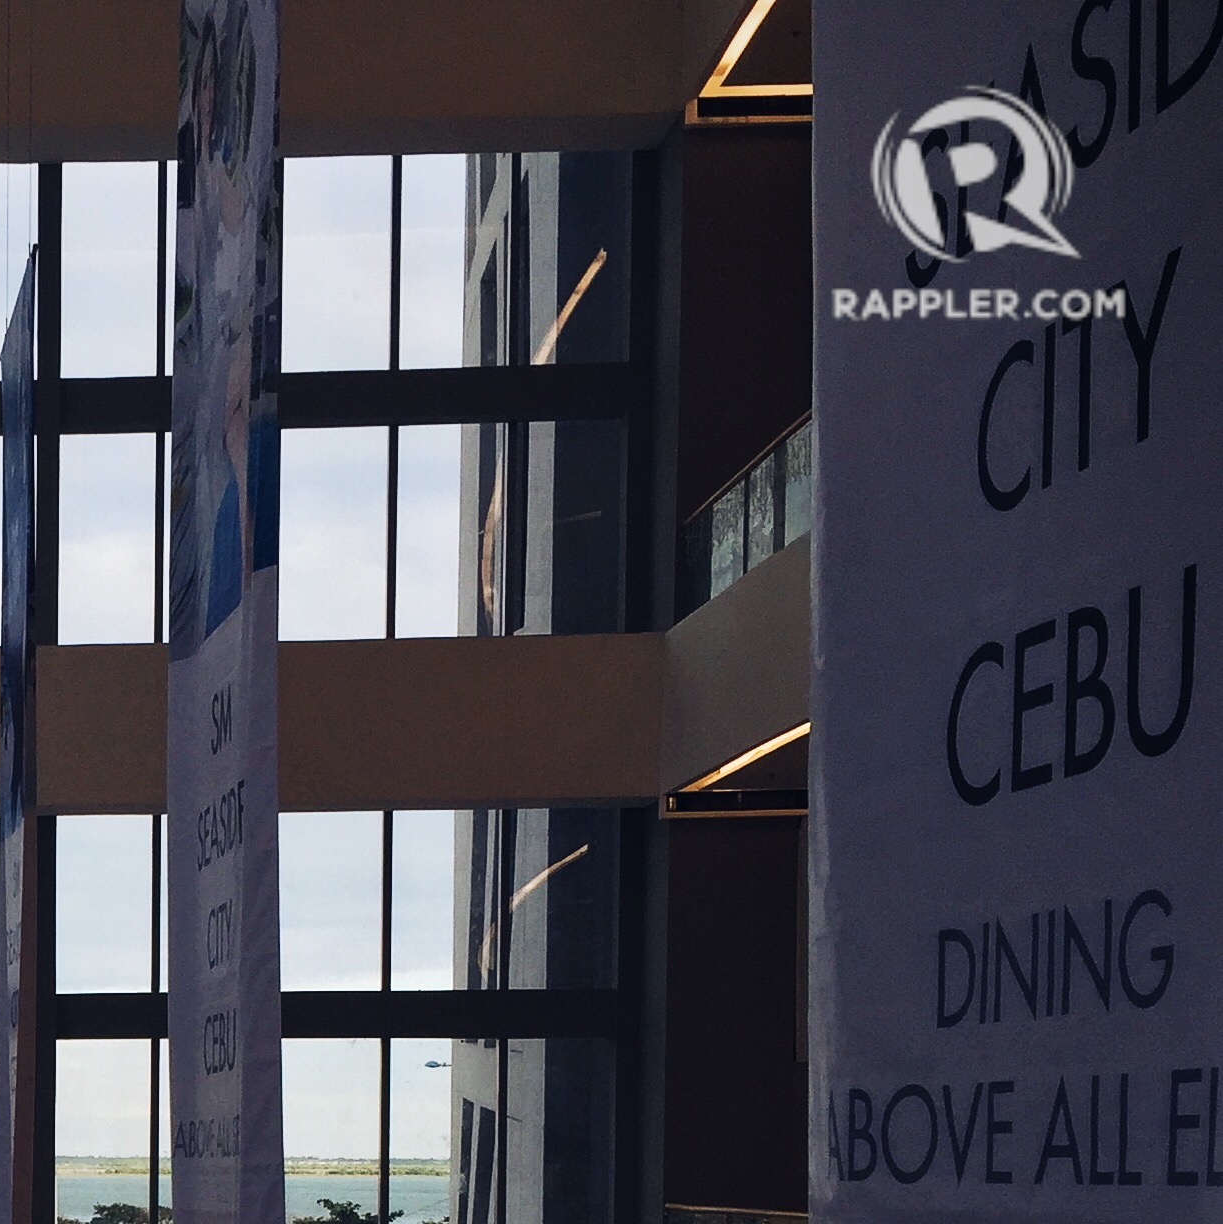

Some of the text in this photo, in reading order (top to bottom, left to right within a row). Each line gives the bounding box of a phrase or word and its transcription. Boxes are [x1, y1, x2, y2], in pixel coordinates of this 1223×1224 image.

[978, 246, 1182, 512] CITY
[947, 563, 1197, 807] CEBU
[936, 889, 1175, 1029] DINING
[203, 1008, 236, 1077] CEBU
[828, 1066, 1223, 1187] ABOVE ALL EL
